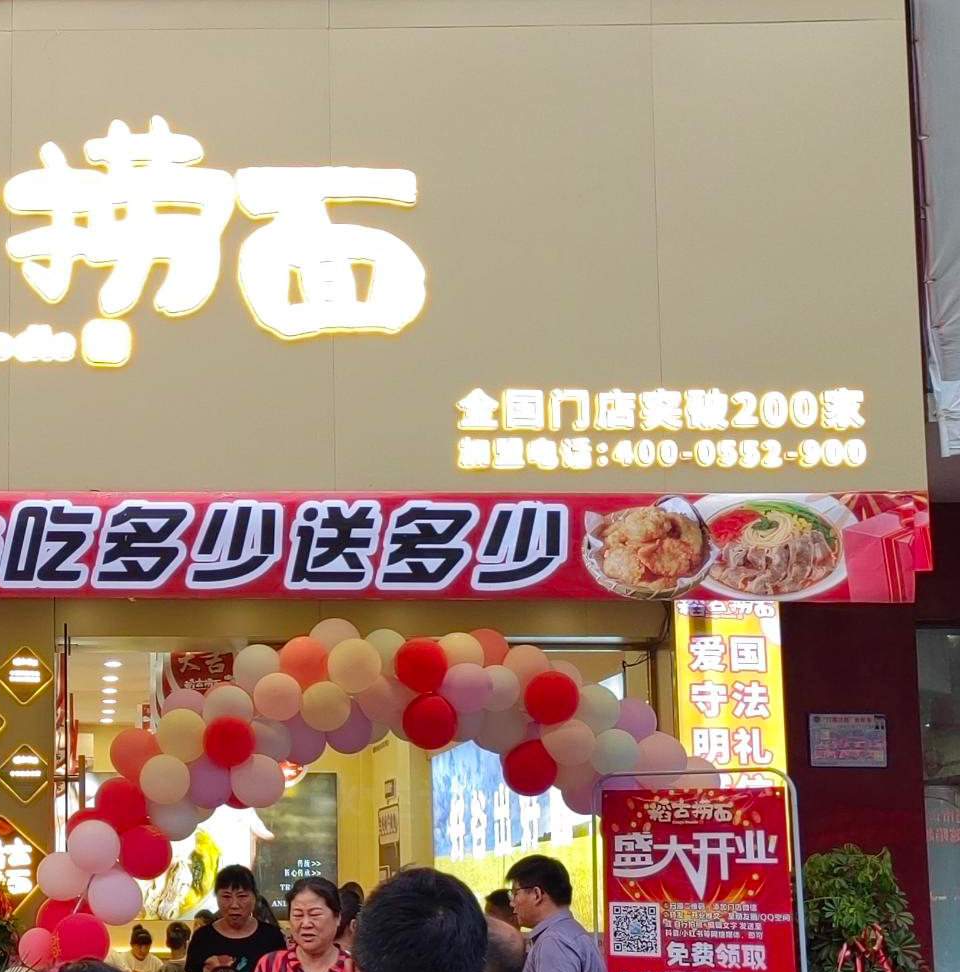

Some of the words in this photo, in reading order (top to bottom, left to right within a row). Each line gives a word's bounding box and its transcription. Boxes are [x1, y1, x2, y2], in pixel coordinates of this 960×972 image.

[457, 388, 865, 431] 全国门店突破200家
[688, 635, 768, 673] 爱国
[690, 680, 771, 718] 守法
[647, 800, 734, 823] 稻古捞面
[612, 830, 779, 900] 盛大开业
[666, 941, 767, 970] 免费领取
